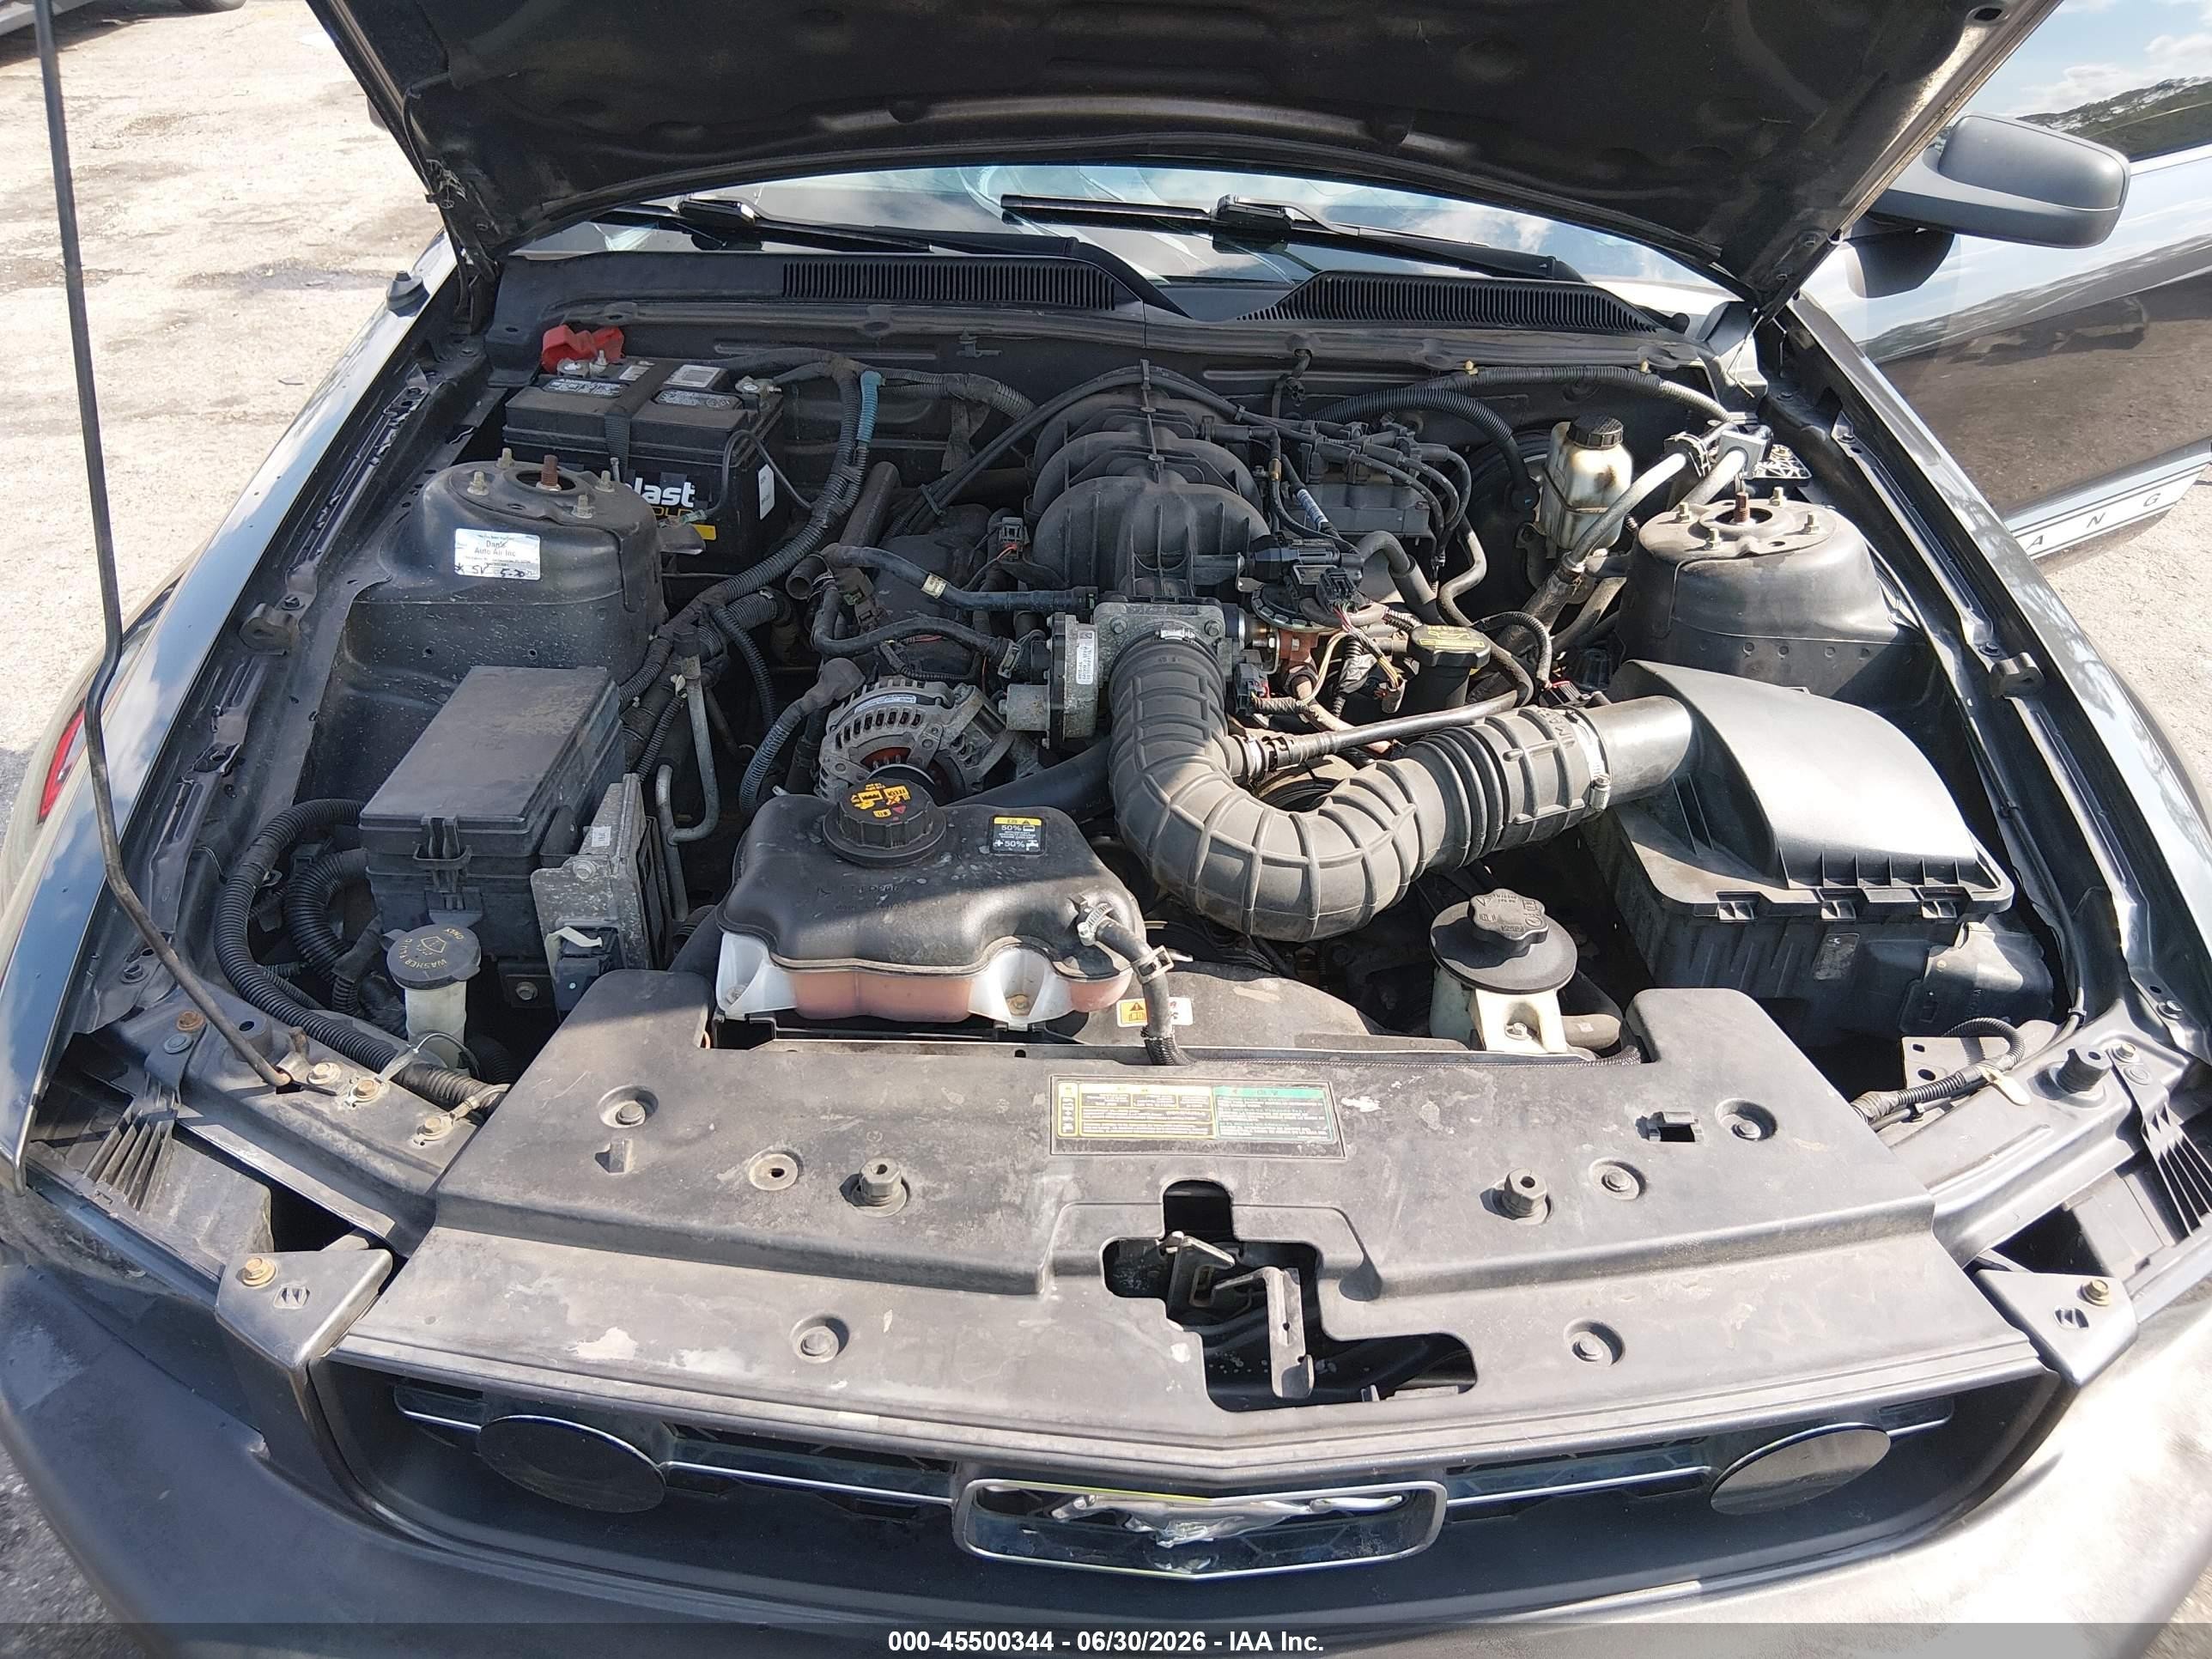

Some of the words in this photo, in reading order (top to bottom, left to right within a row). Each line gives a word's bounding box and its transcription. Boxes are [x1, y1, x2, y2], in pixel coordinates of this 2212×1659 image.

[625, 477, 695, 507] last
[652, 506, 694, 517] OLD
[398, 938, 413, 959] FLUID
[404, 957, 447, 969] WASHER
